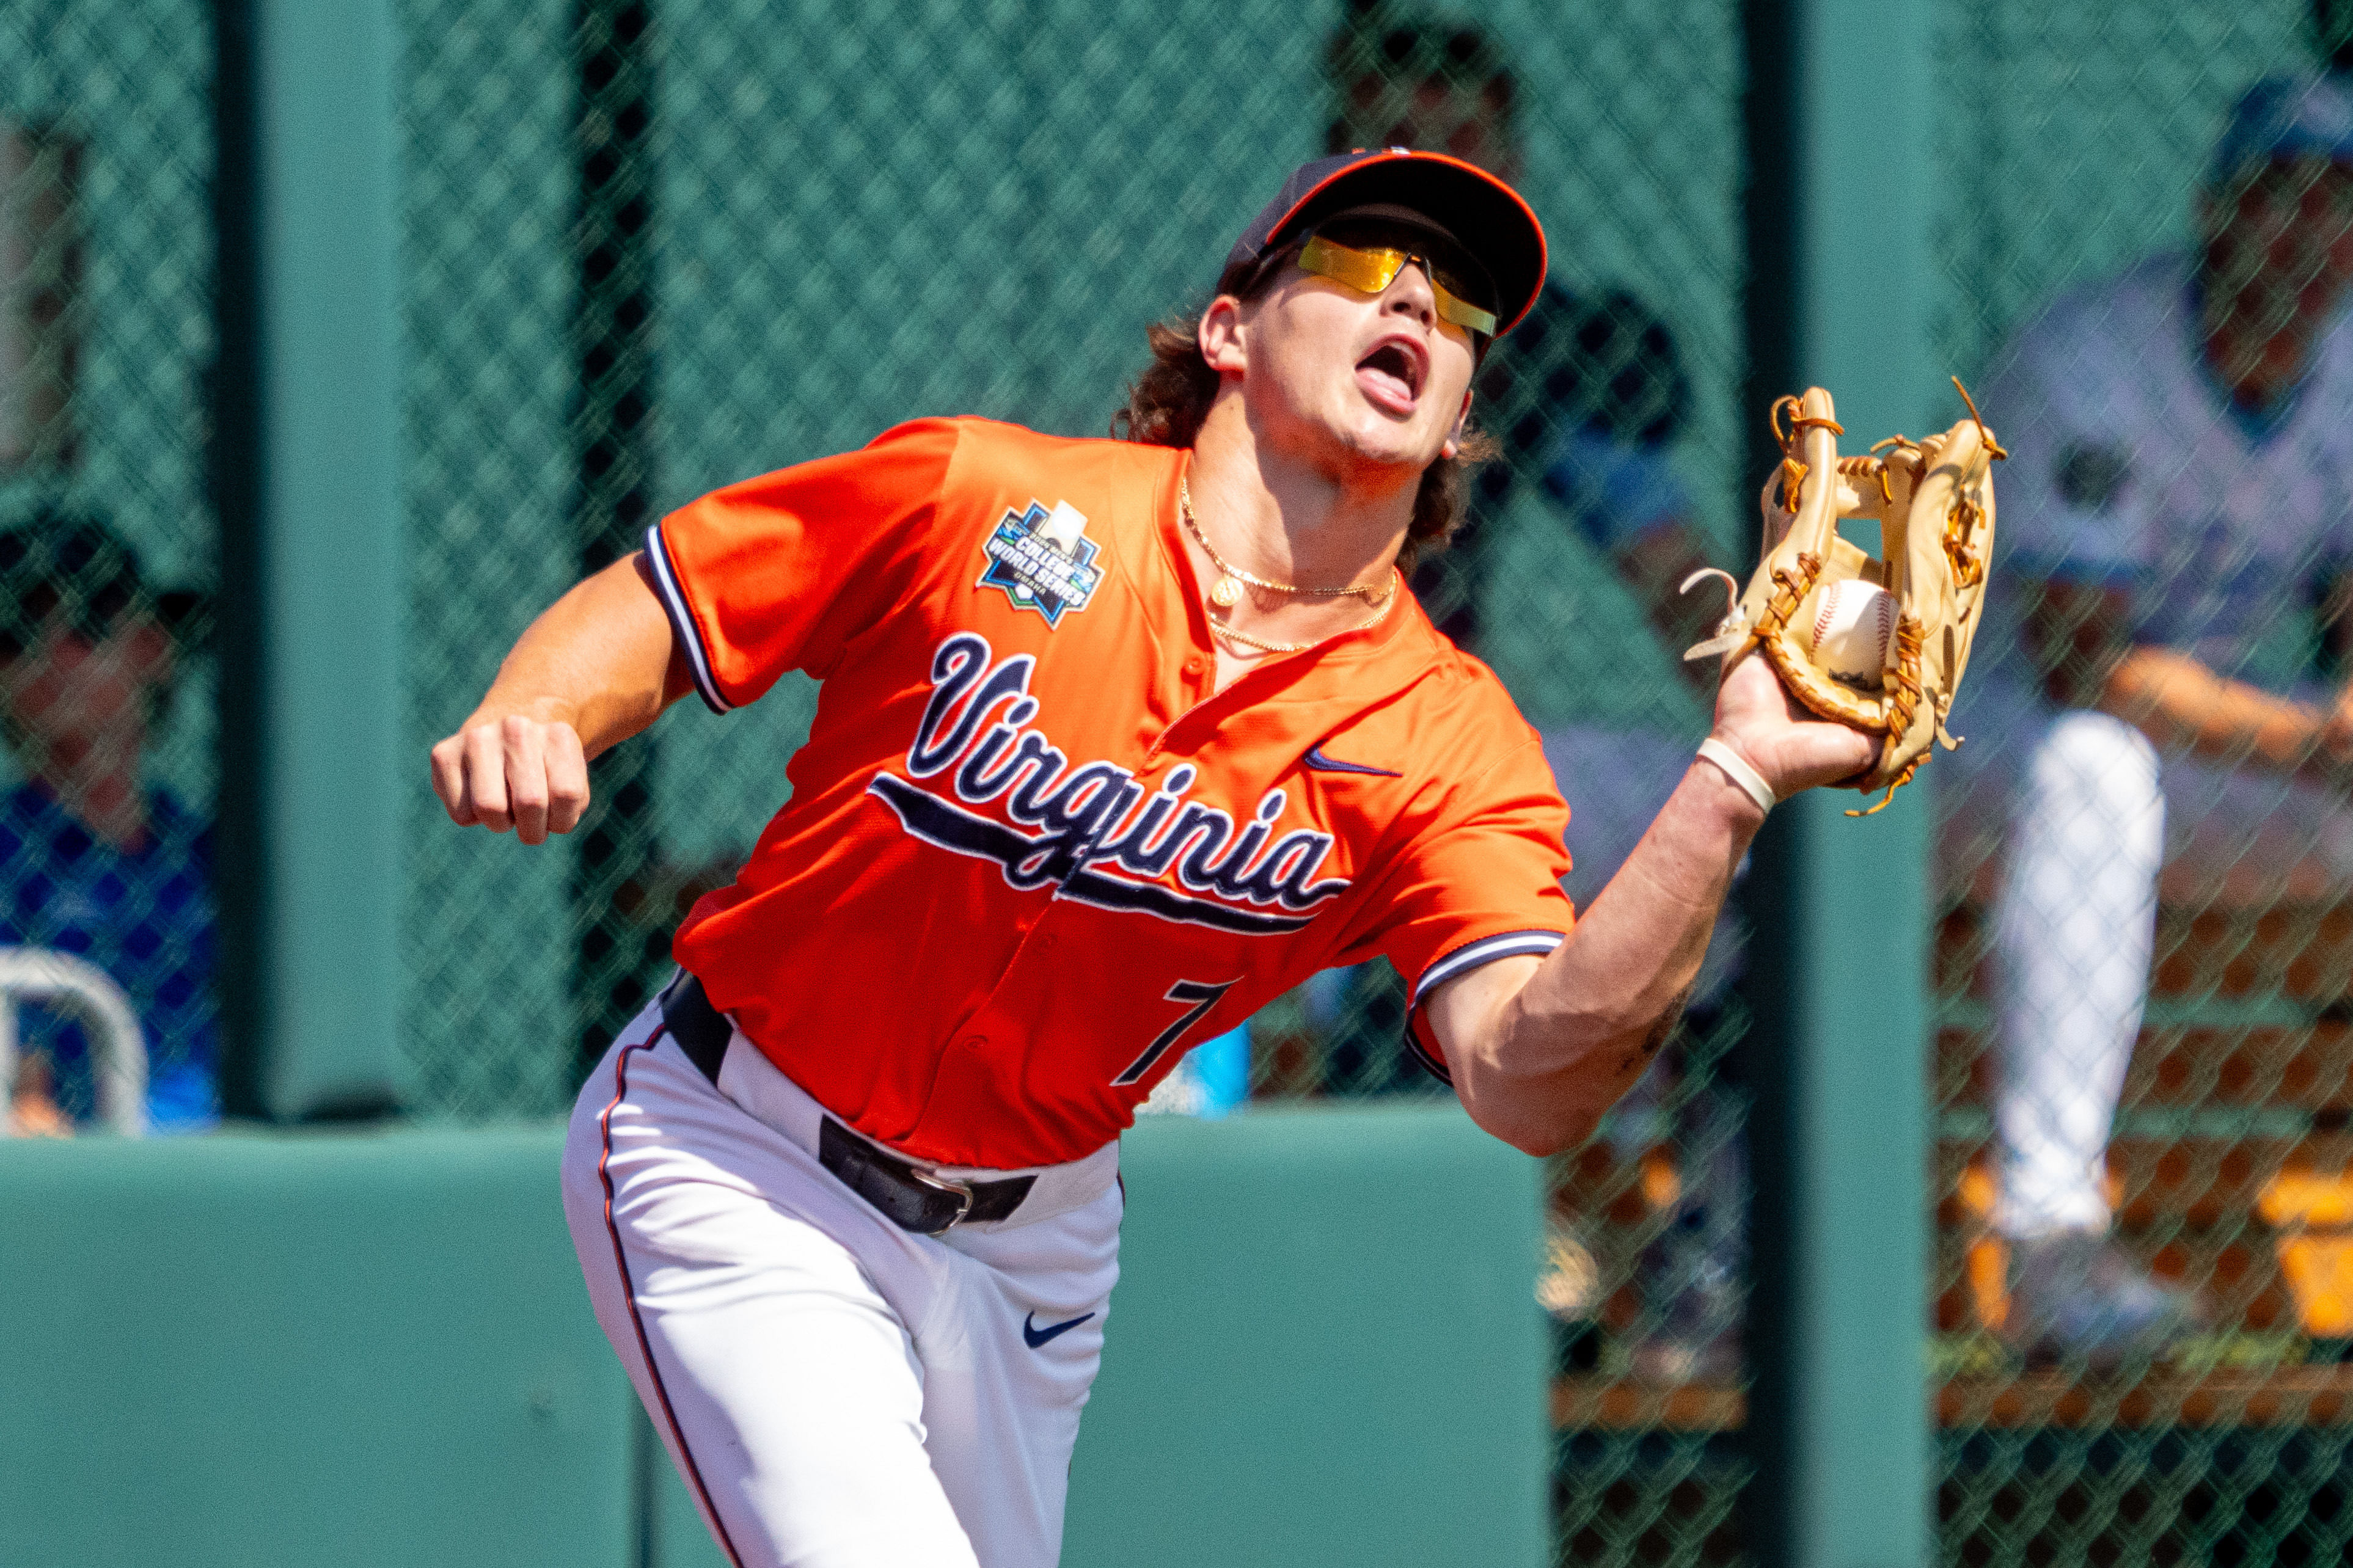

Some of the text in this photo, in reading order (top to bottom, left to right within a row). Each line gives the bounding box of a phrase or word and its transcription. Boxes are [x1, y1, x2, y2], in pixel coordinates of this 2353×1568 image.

[988, 538, 1086, 606] WORLD SERIES
[1014, 572, 1047, 595] OMAHA
[1015, 536, 1075, 581] COLLEGE
[906, 630, 1353, 911] Virginia
[1108, 975, 1245, 1087] 7
